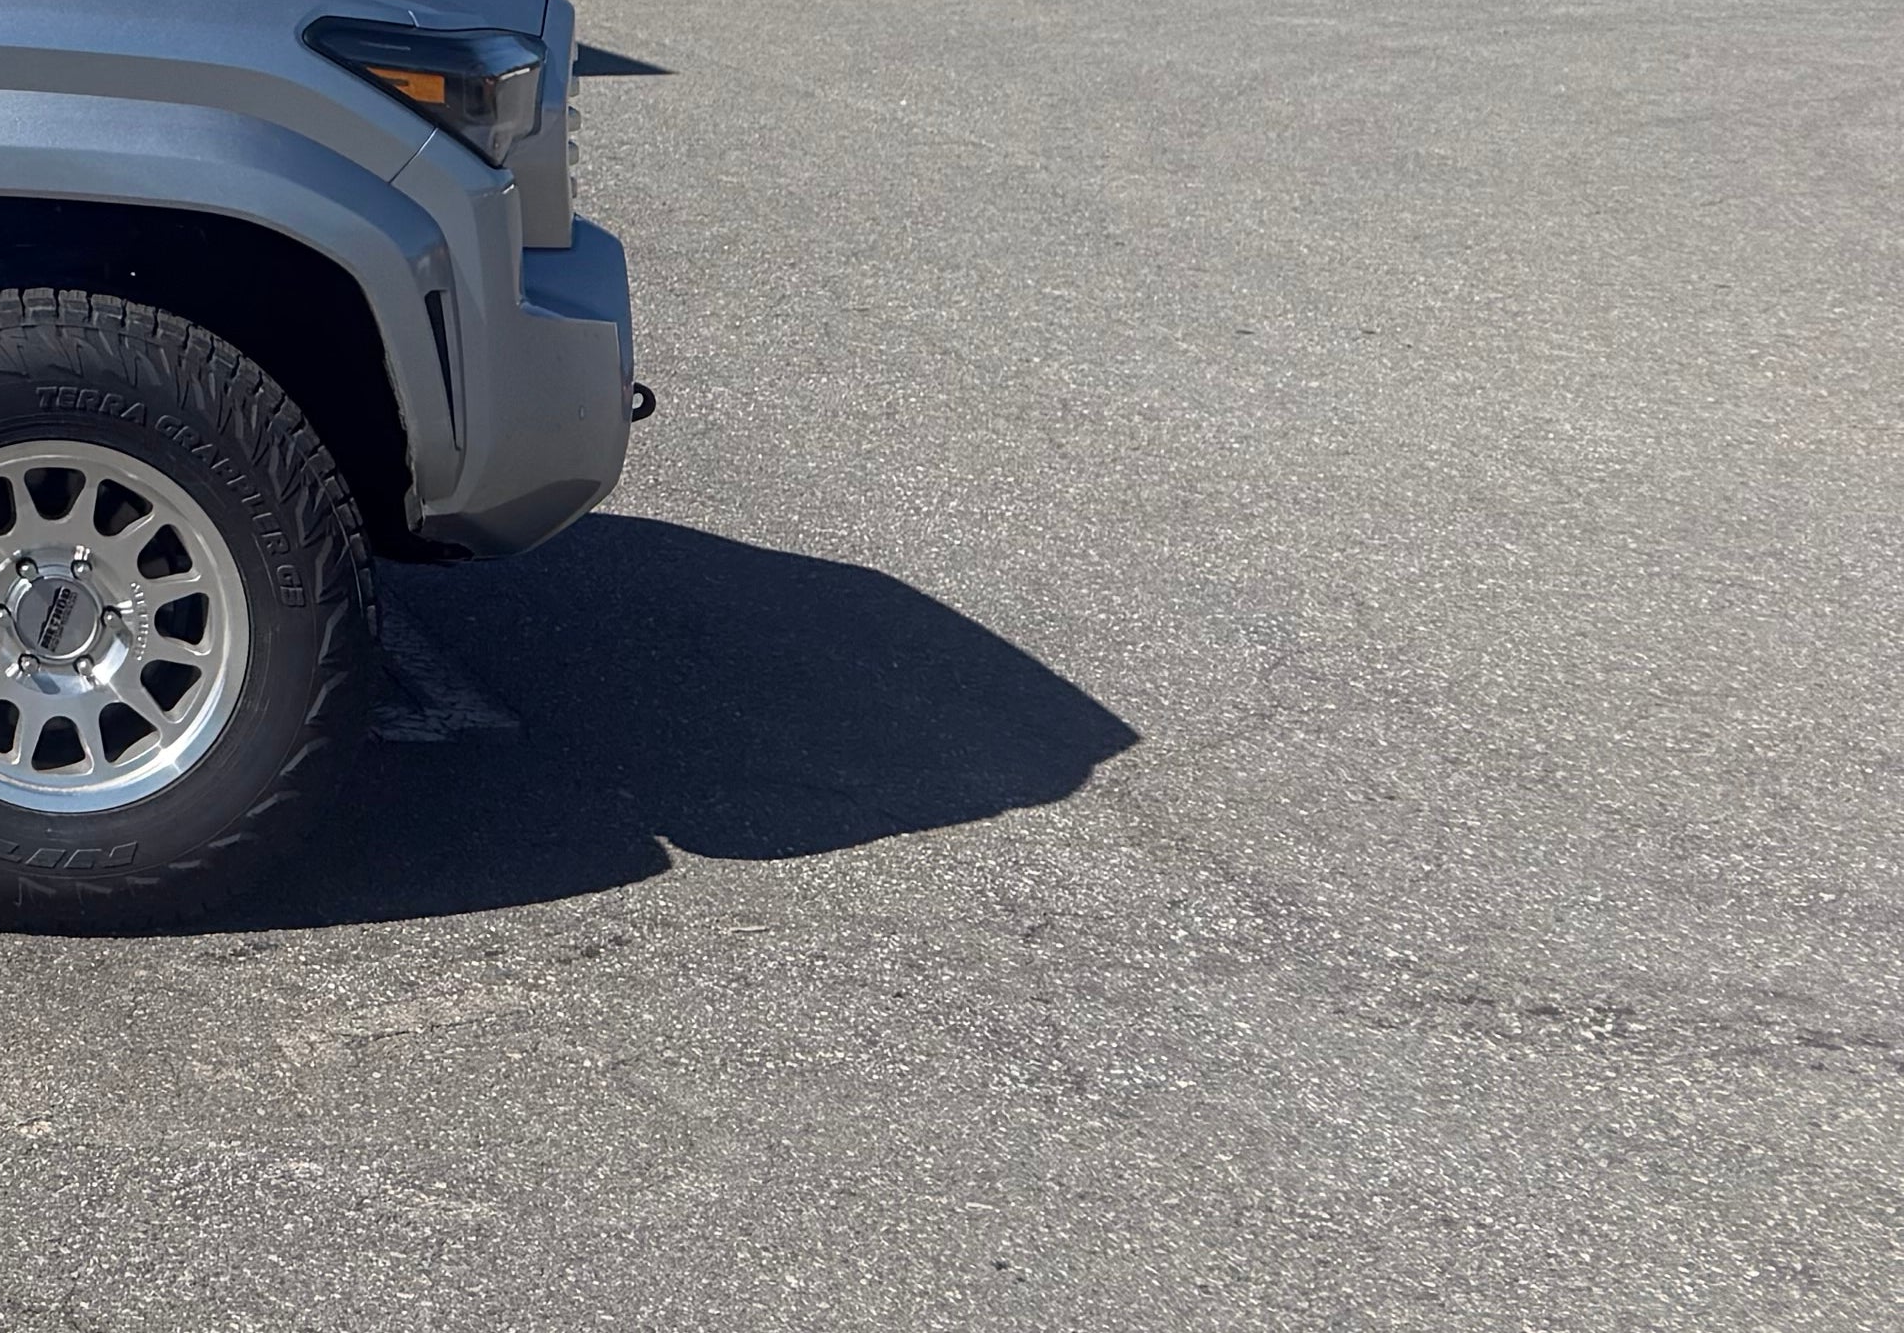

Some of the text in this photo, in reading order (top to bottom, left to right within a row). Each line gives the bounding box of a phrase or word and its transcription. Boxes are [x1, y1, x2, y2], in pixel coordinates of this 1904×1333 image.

[35, 386, 148, 426] TERRA
[154, 414, 291, 557] GRAPPLER
[41, 588, 71, 649] METHOD
